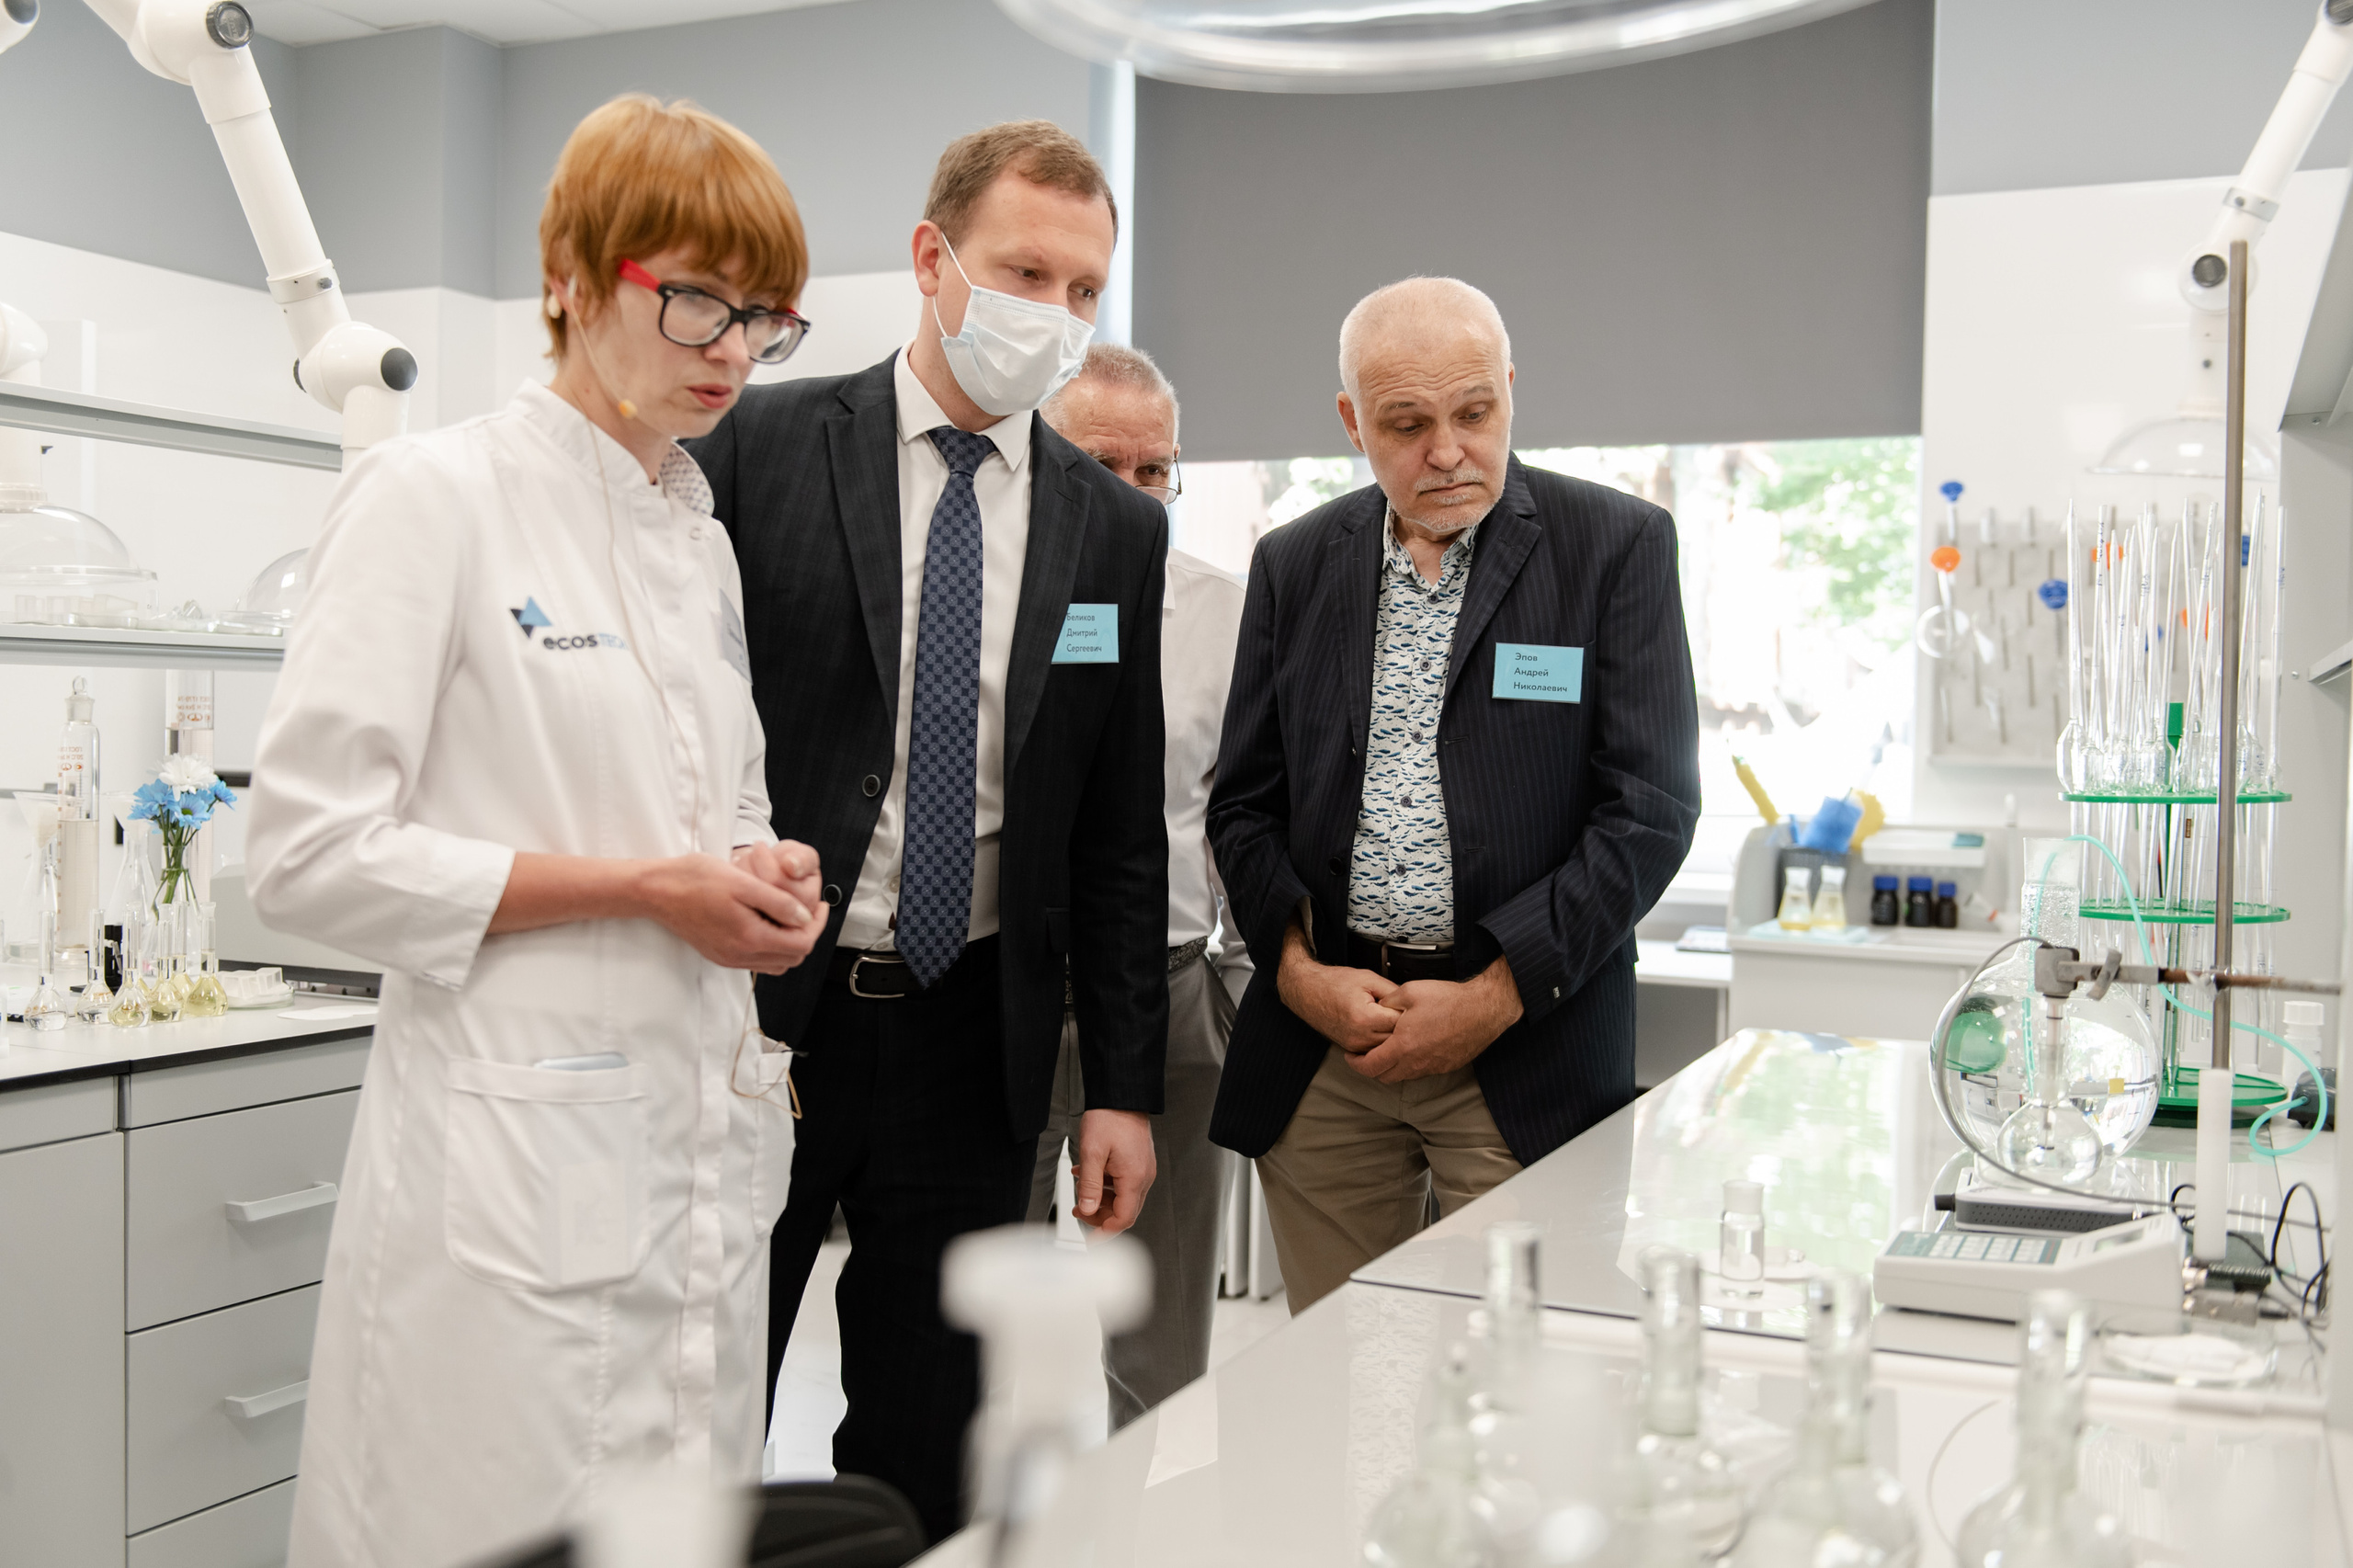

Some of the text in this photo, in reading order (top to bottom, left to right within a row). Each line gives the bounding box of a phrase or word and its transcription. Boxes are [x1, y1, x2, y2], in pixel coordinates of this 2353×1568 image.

[1066, 628, 1097, 638] Дмитрий
[1066, 643, 1102, 653] Сергеевич
[1515, 653, 1538, 661] Эпов
[1514, 667, 1549, 677] Андрей
[1513, 681, 1568, 692] Николаевич
